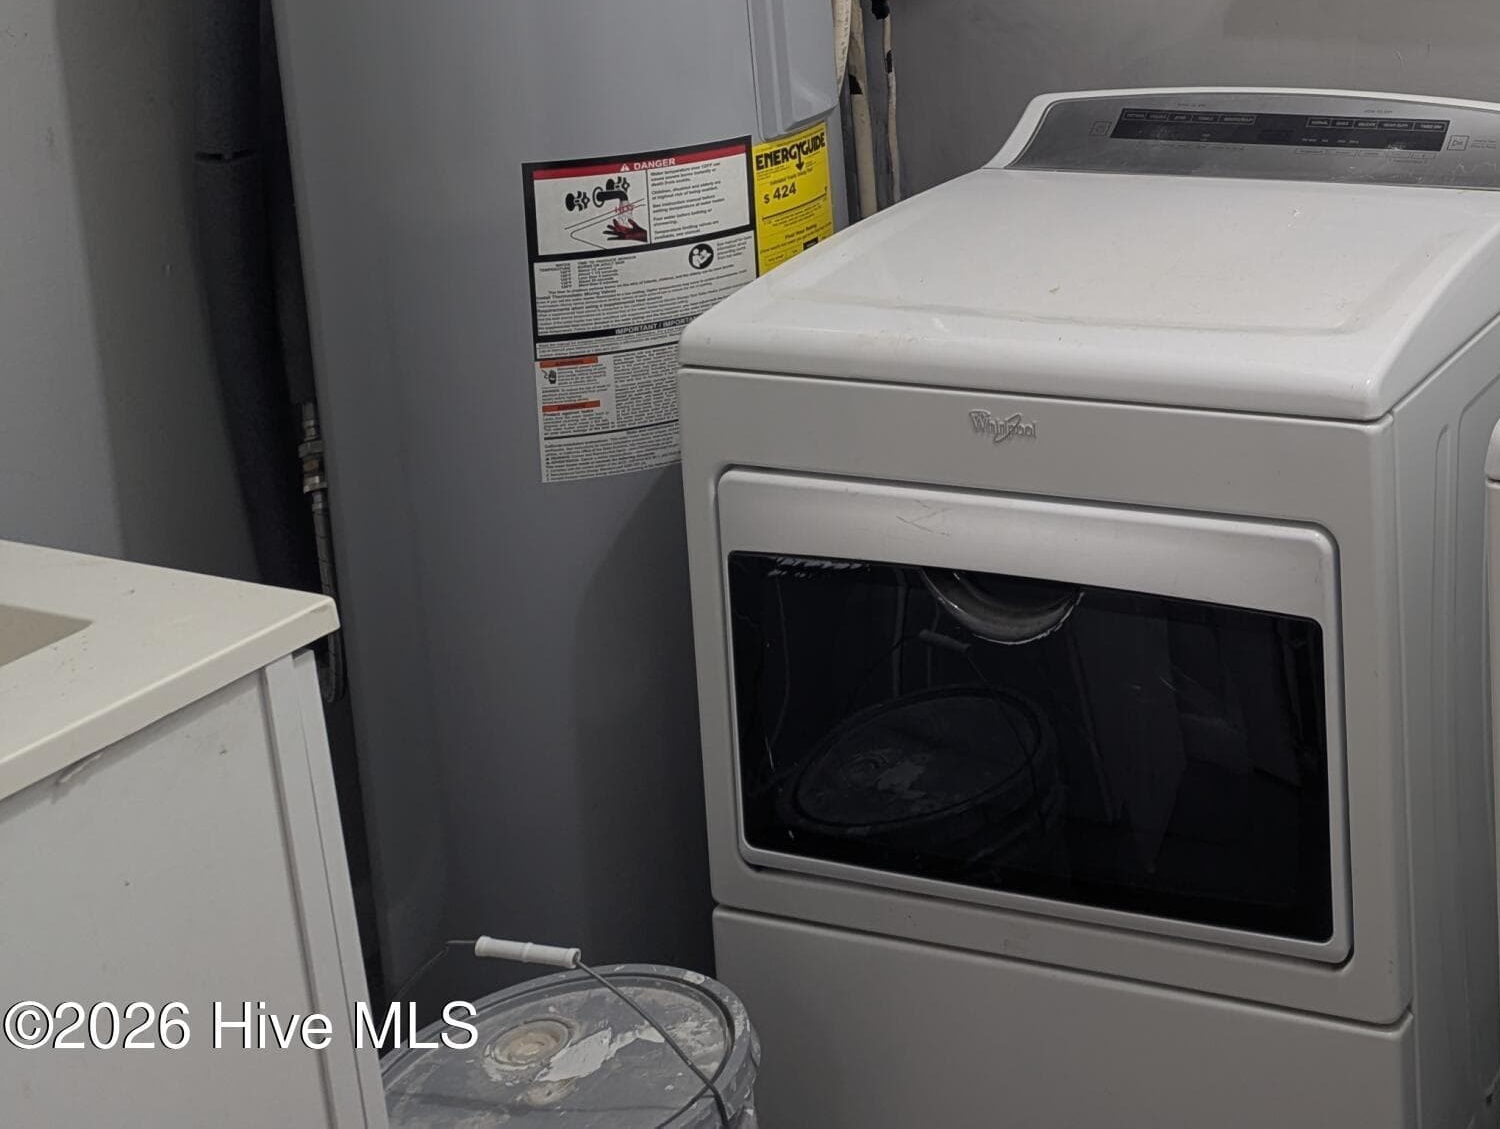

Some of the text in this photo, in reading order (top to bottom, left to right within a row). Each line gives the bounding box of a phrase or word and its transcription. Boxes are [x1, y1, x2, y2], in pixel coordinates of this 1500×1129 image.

[755, 132, 825, 171] ENERGYGUIDE
[634, 157, 676, 171] DANGER
[773, 182, 797, 202] 424
[615, 322, 658, 335] IMPORTANT
[968, 409, 1037, 443] Whirlpool
